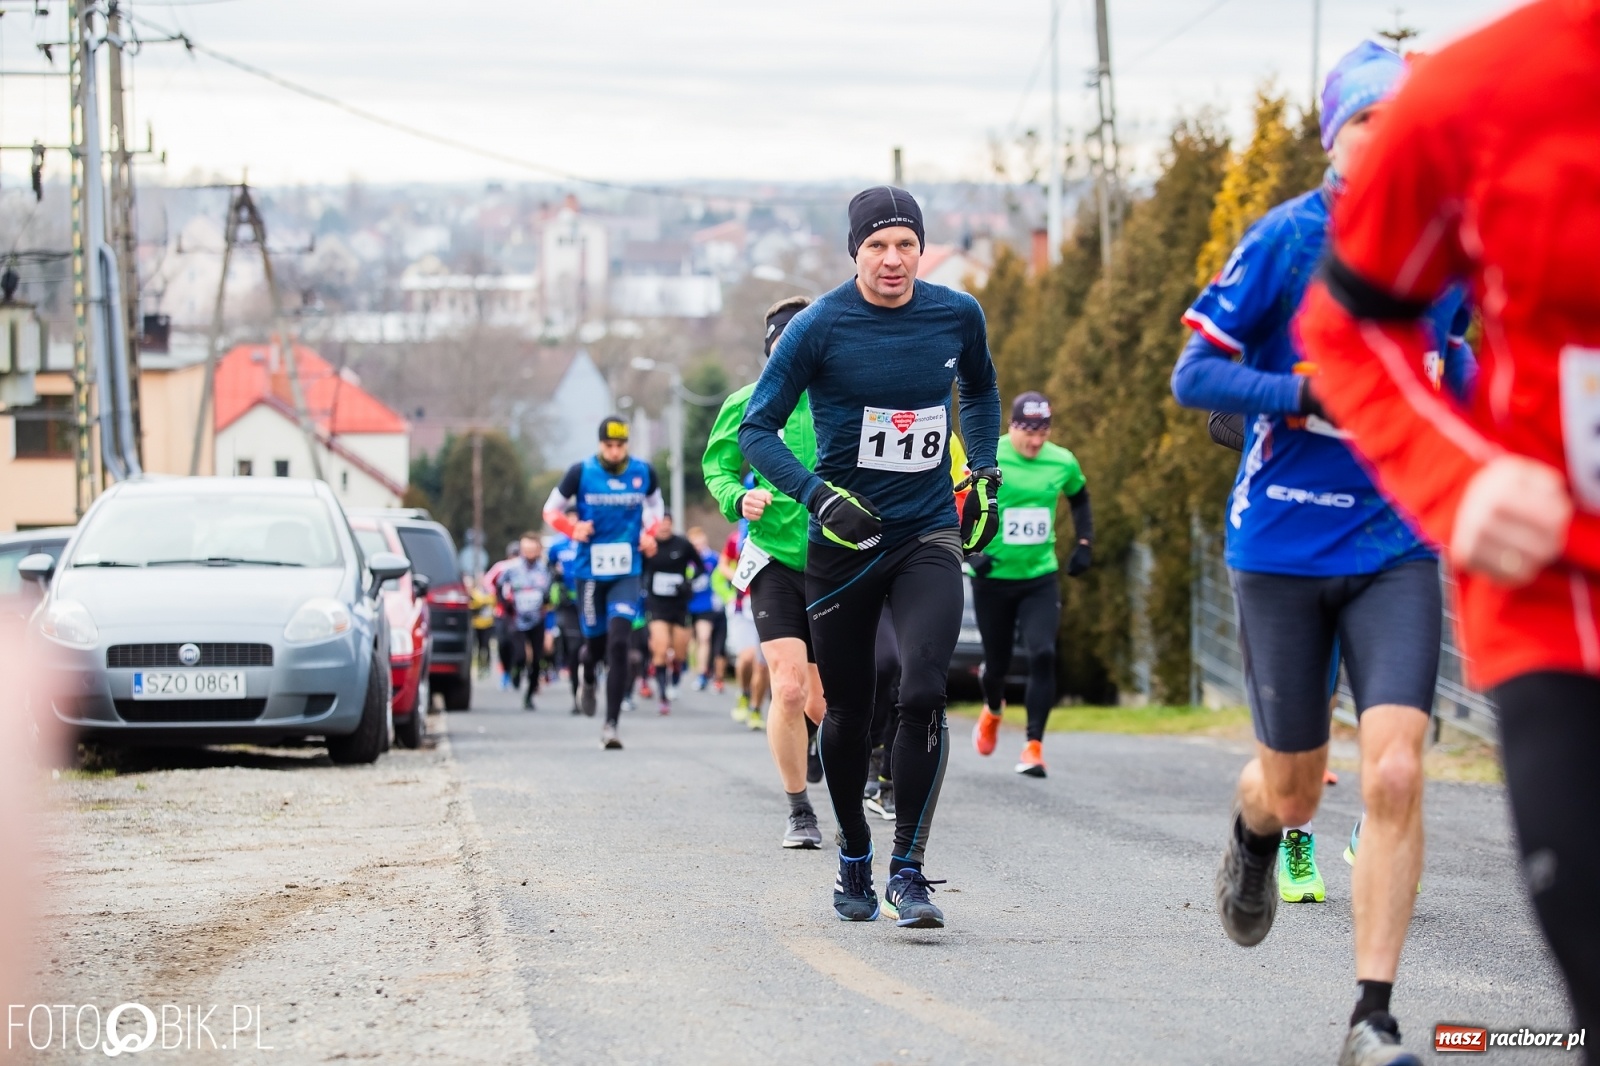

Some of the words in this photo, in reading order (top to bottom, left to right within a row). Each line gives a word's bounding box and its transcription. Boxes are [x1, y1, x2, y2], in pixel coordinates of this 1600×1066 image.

[944, 357, 957, 369] 4F
[868, 431, 941, 460] 118
[1008, 522, 1047, 537] 268
[596, 555, 629, 569] 216
[147, 673, 188, 694] SZO
[195, 674, 239, 693] 08G1
